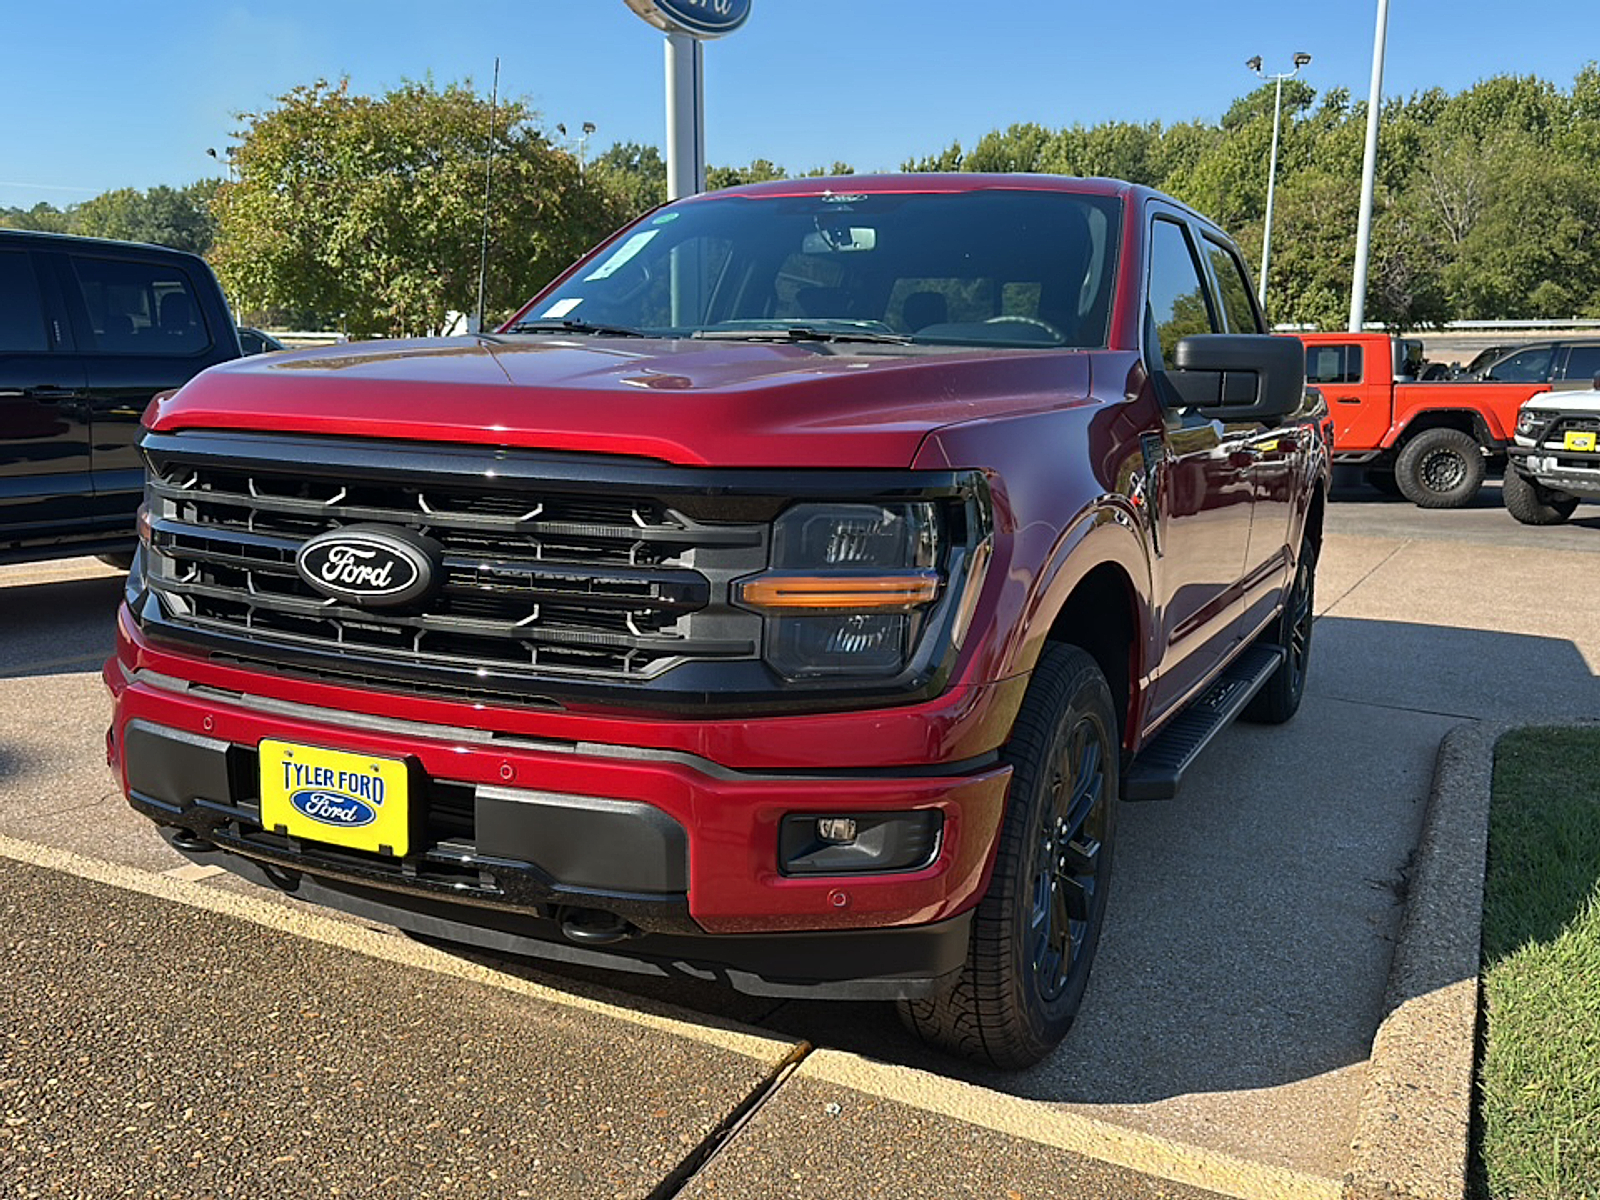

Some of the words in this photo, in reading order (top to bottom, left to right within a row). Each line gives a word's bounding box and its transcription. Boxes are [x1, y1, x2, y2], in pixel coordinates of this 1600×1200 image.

[321, 546, 395, 588] Ford
[282, 761, 335, 790] TYLER
[338, 771, 385, 806] FORD
[305, 793, 358, 822] Ford
